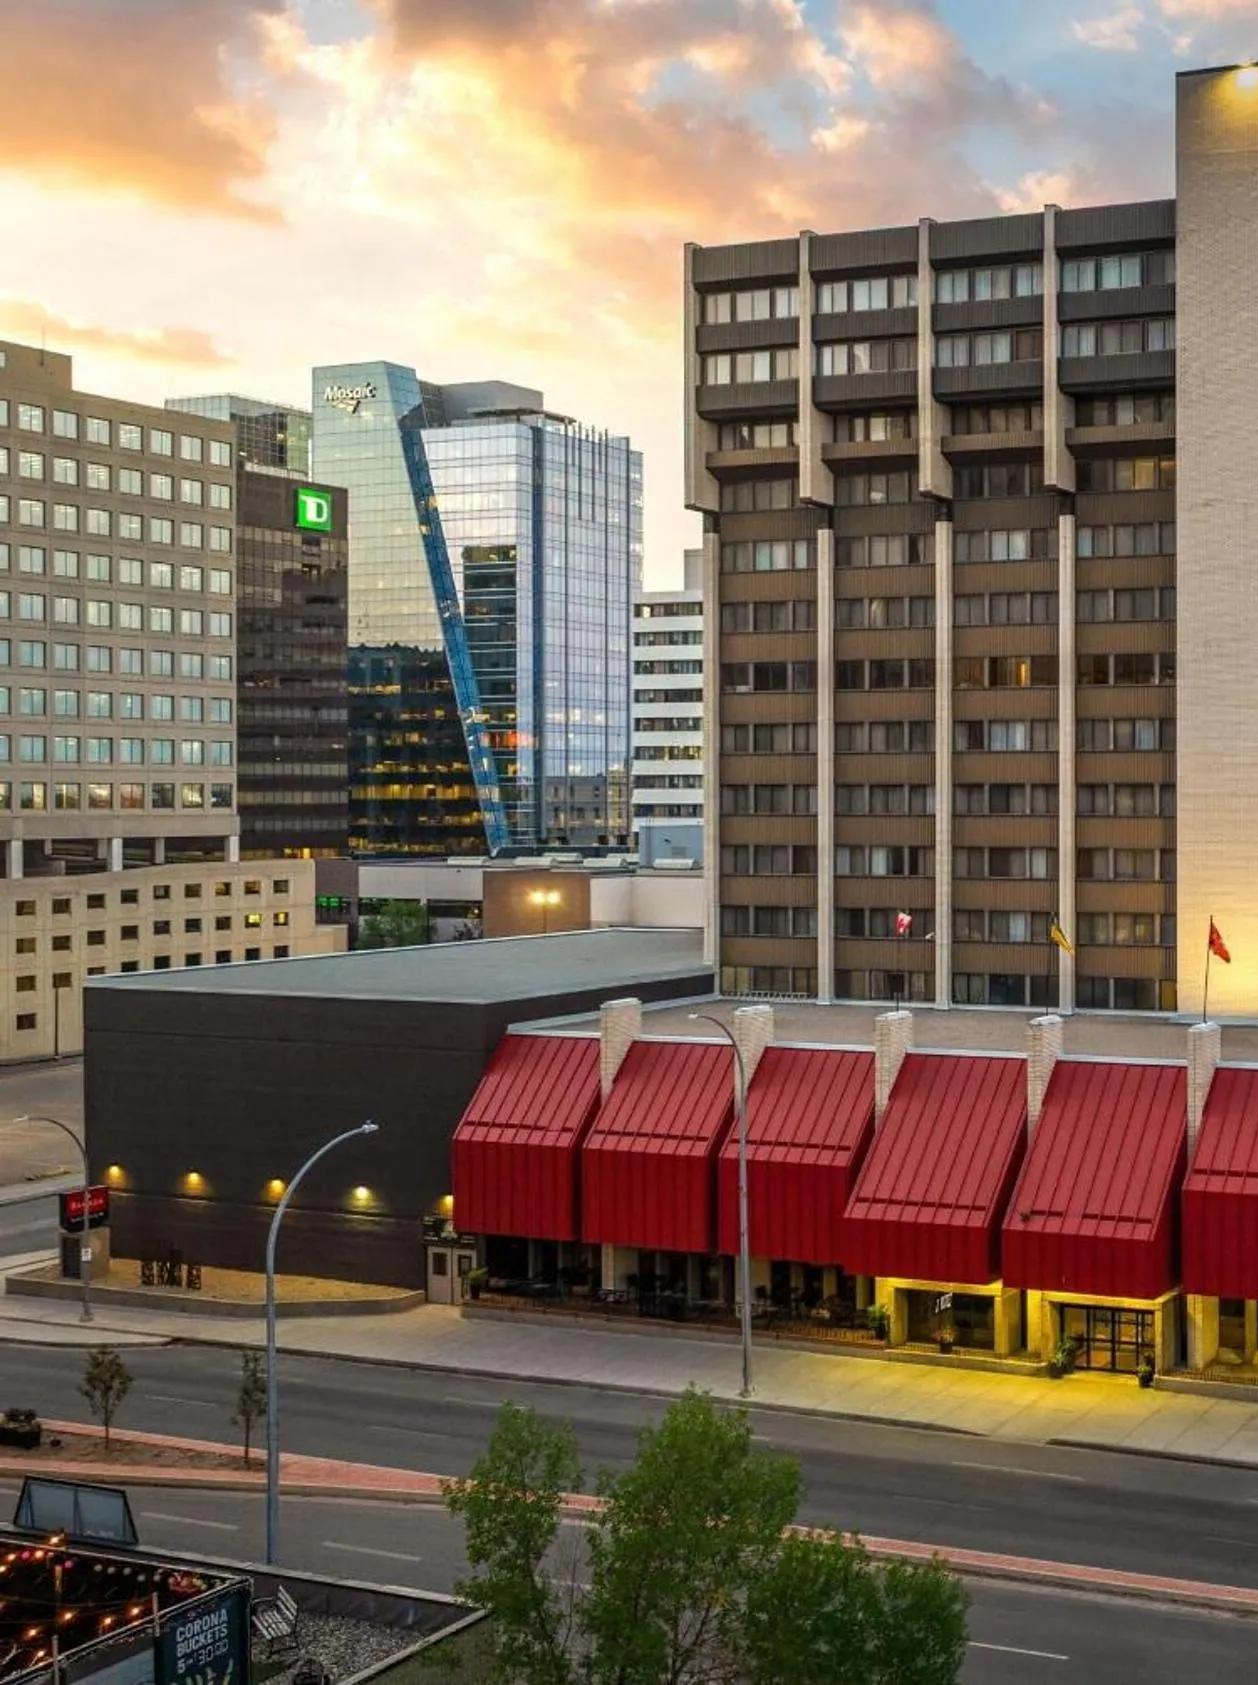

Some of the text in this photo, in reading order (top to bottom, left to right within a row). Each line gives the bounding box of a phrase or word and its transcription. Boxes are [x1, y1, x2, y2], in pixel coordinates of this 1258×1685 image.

[324, 382, 377, 401] Mosaic
[299, 495, 328, 522] TD
[176, 1608, 228, 1642] CORONA
[176, 1623, 228, 1658] BUCKETS
